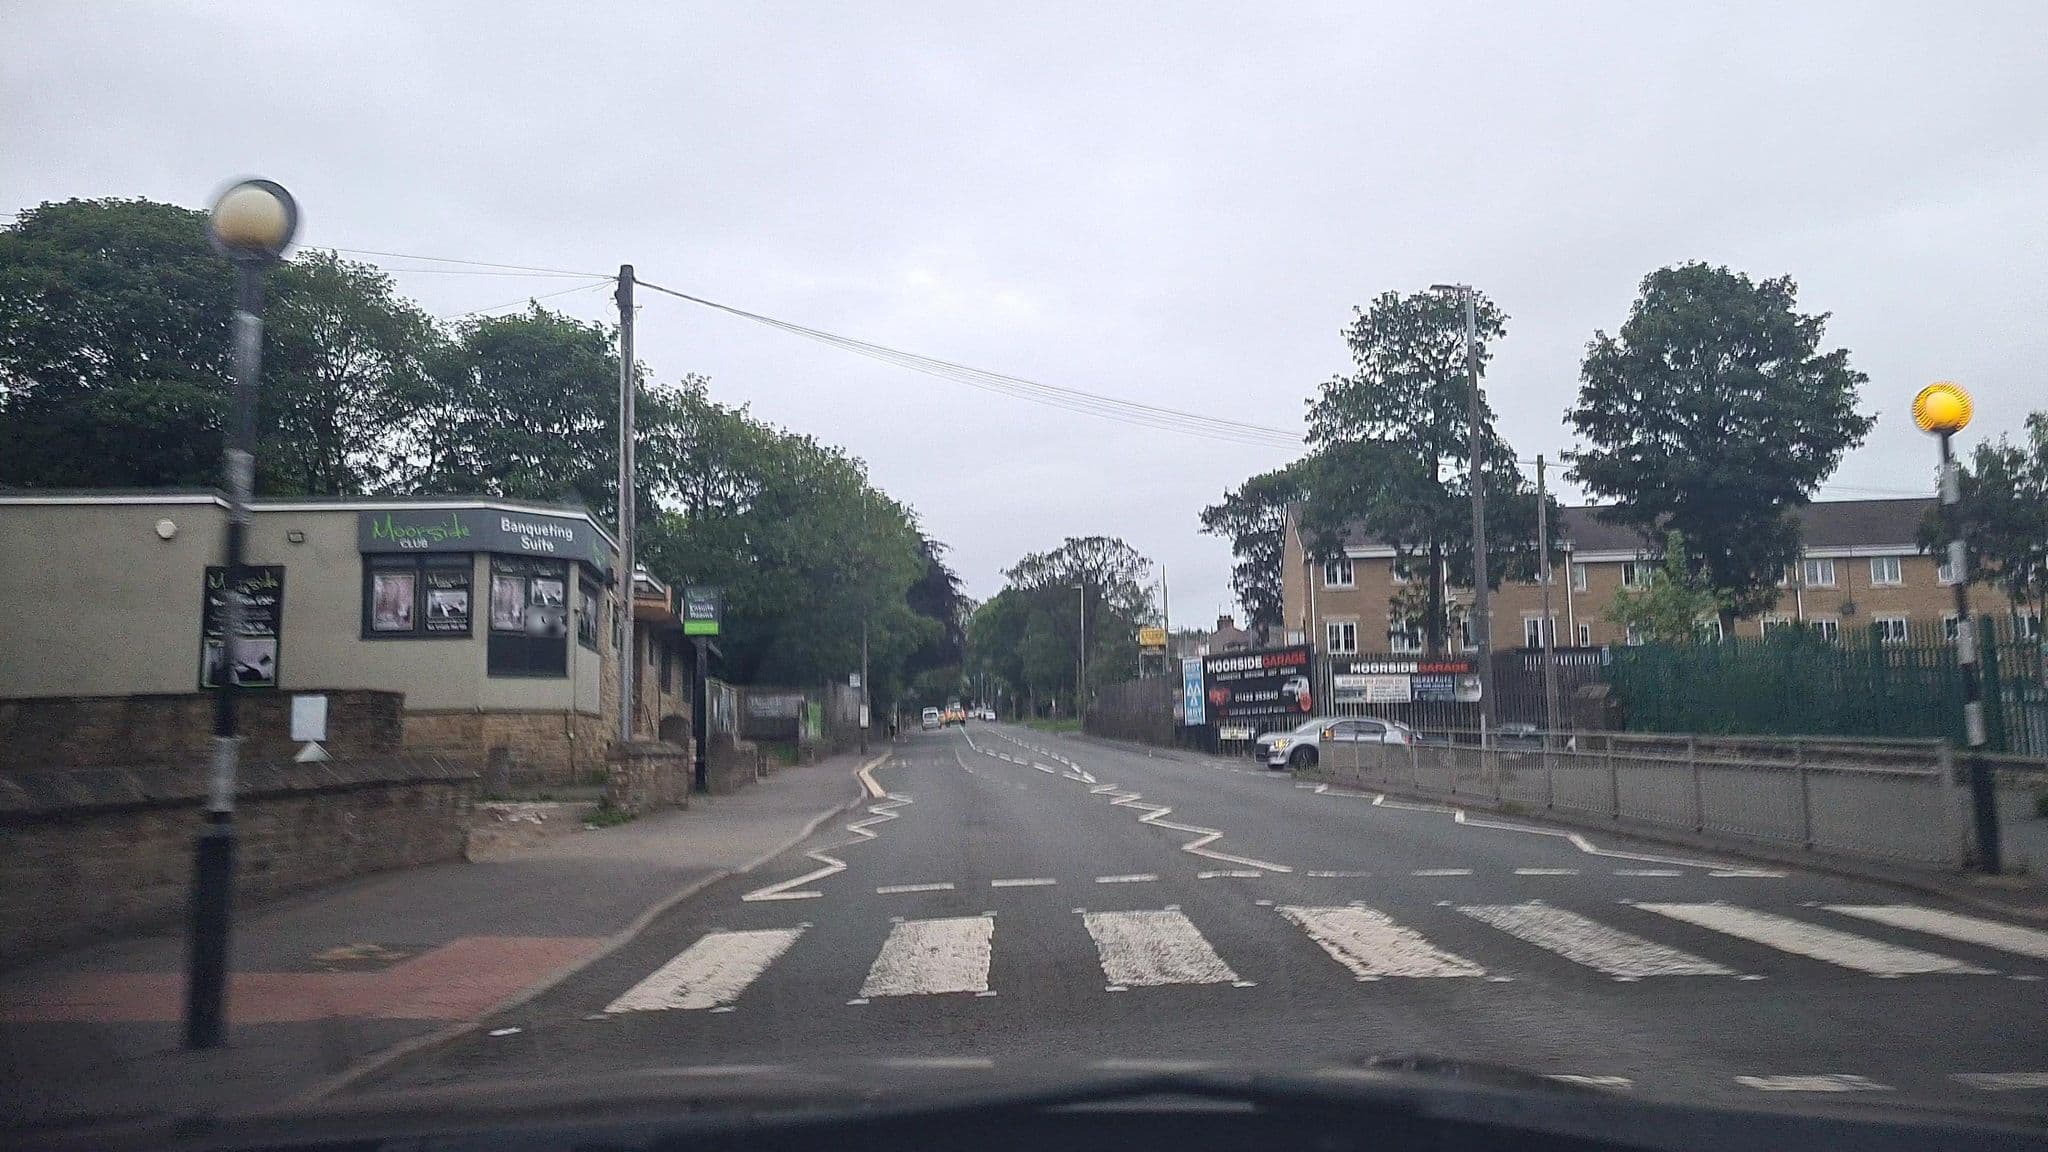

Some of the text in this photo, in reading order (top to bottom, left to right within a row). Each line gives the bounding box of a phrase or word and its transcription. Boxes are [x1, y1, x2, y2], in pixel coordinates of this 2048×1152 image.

[372, 513, 471, 542] Moorside
[500, 516, 574, 542] Banqueting
[399, 538, 429, 548] CLUB
[520, 535, 555, 553] Suite
[1207, 656, 1262, 674] MOORSIDE
[1350, 661, 1418, 674] MOORSIDE
